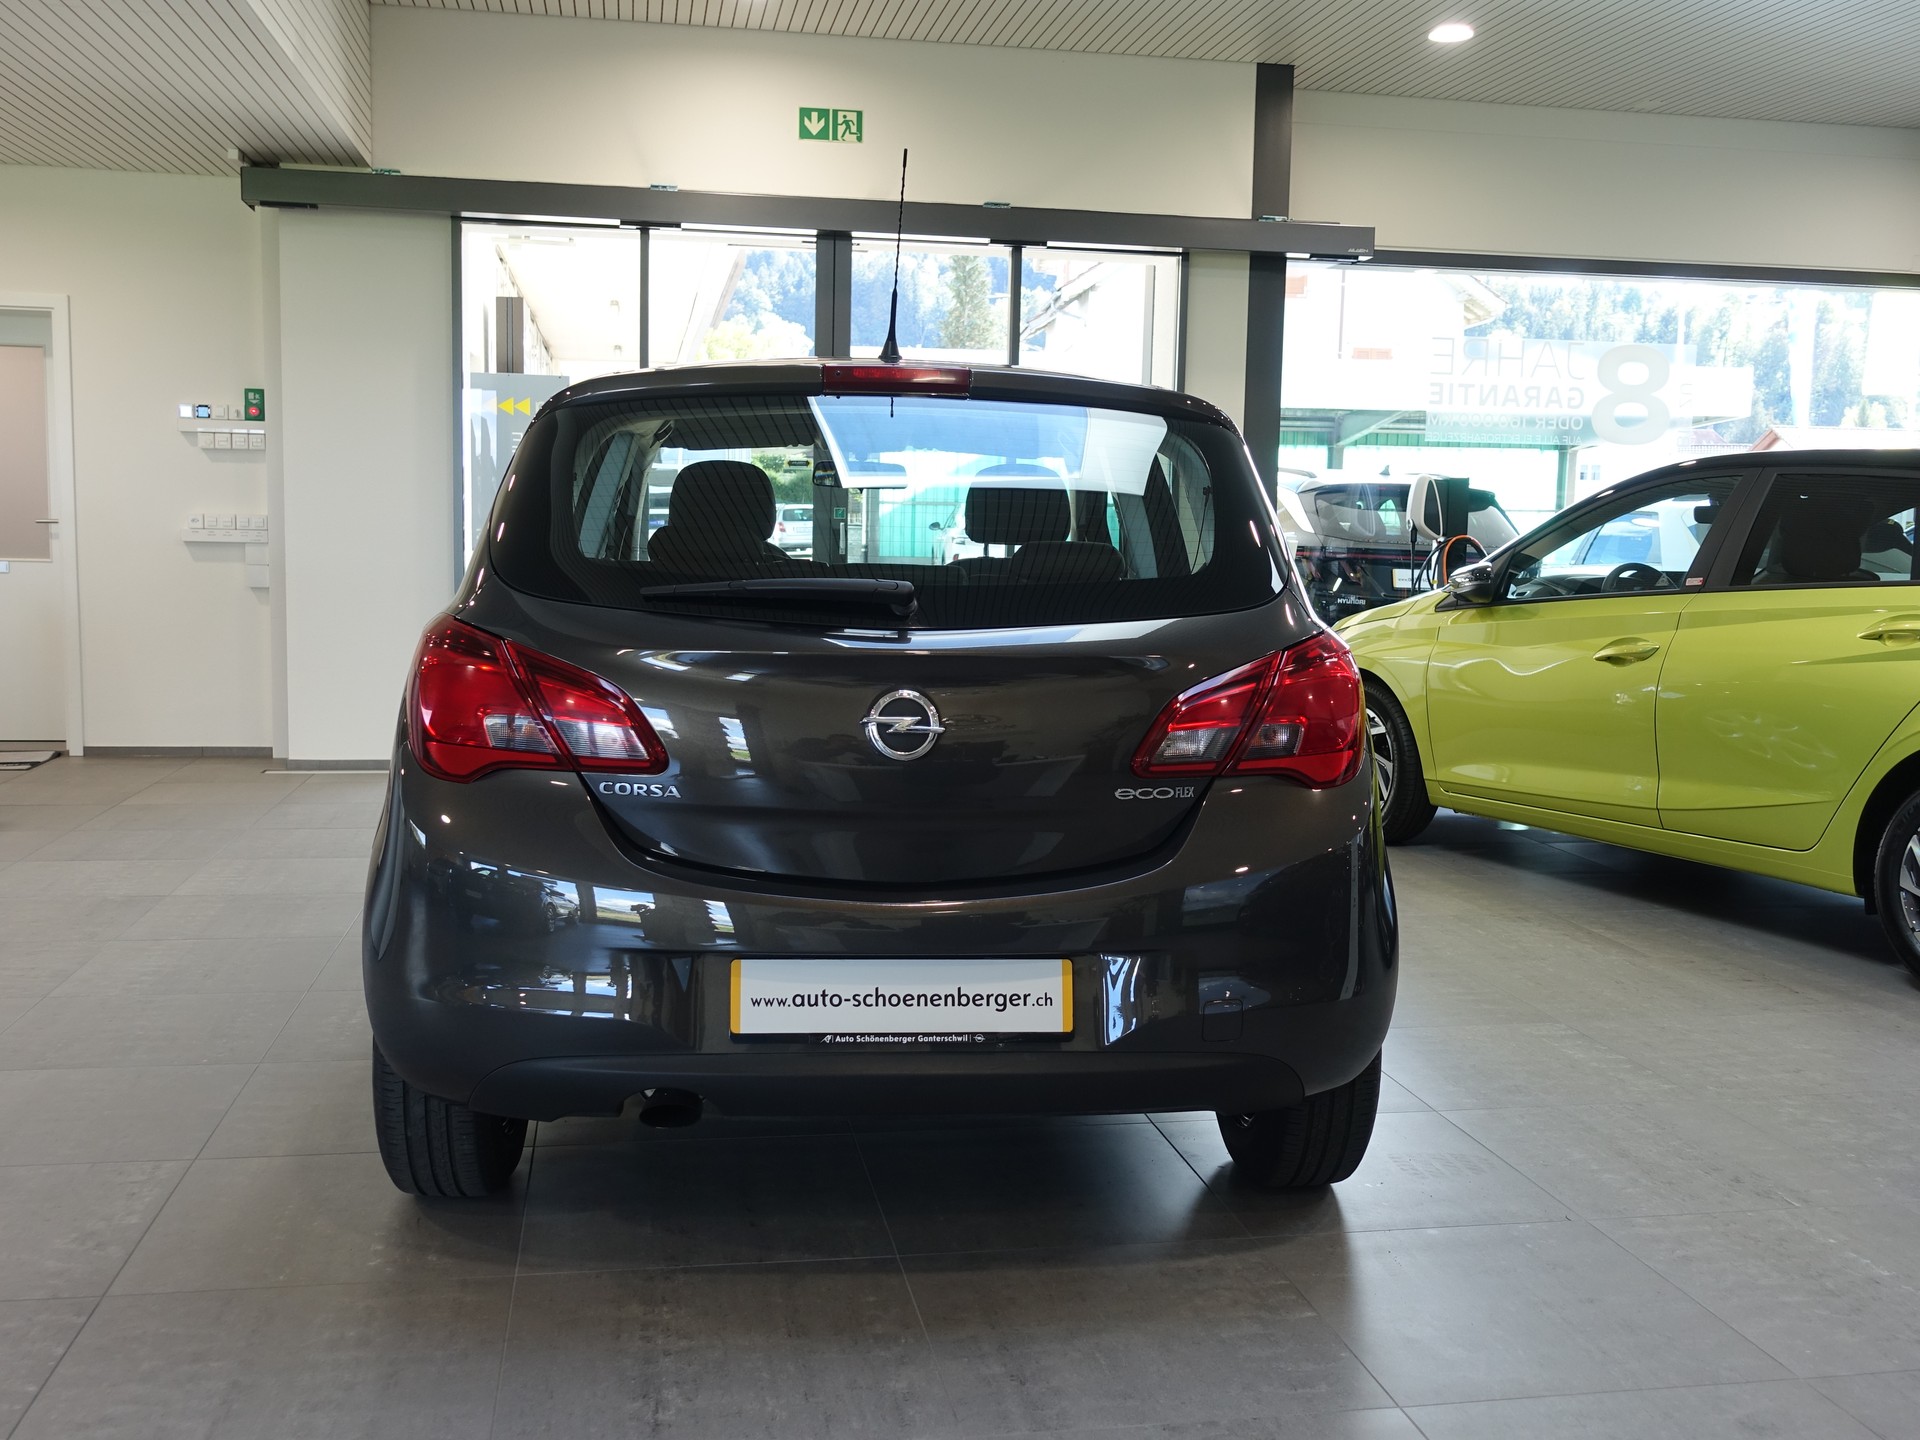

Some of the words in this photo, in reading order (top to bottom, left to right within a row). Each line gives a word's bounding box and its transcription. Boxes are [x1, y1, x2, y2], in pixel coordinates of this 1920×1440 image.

[598, 781, 682, 799] CORSA
[750, 986, 1054, 1013] www.auto-schoenenberger.ch
[835, 1034, 854, 1043] Auto
[856, 1034, 916, 1044] Schönenberger
[918, 1034, 968, 1043] Ganterschwil
